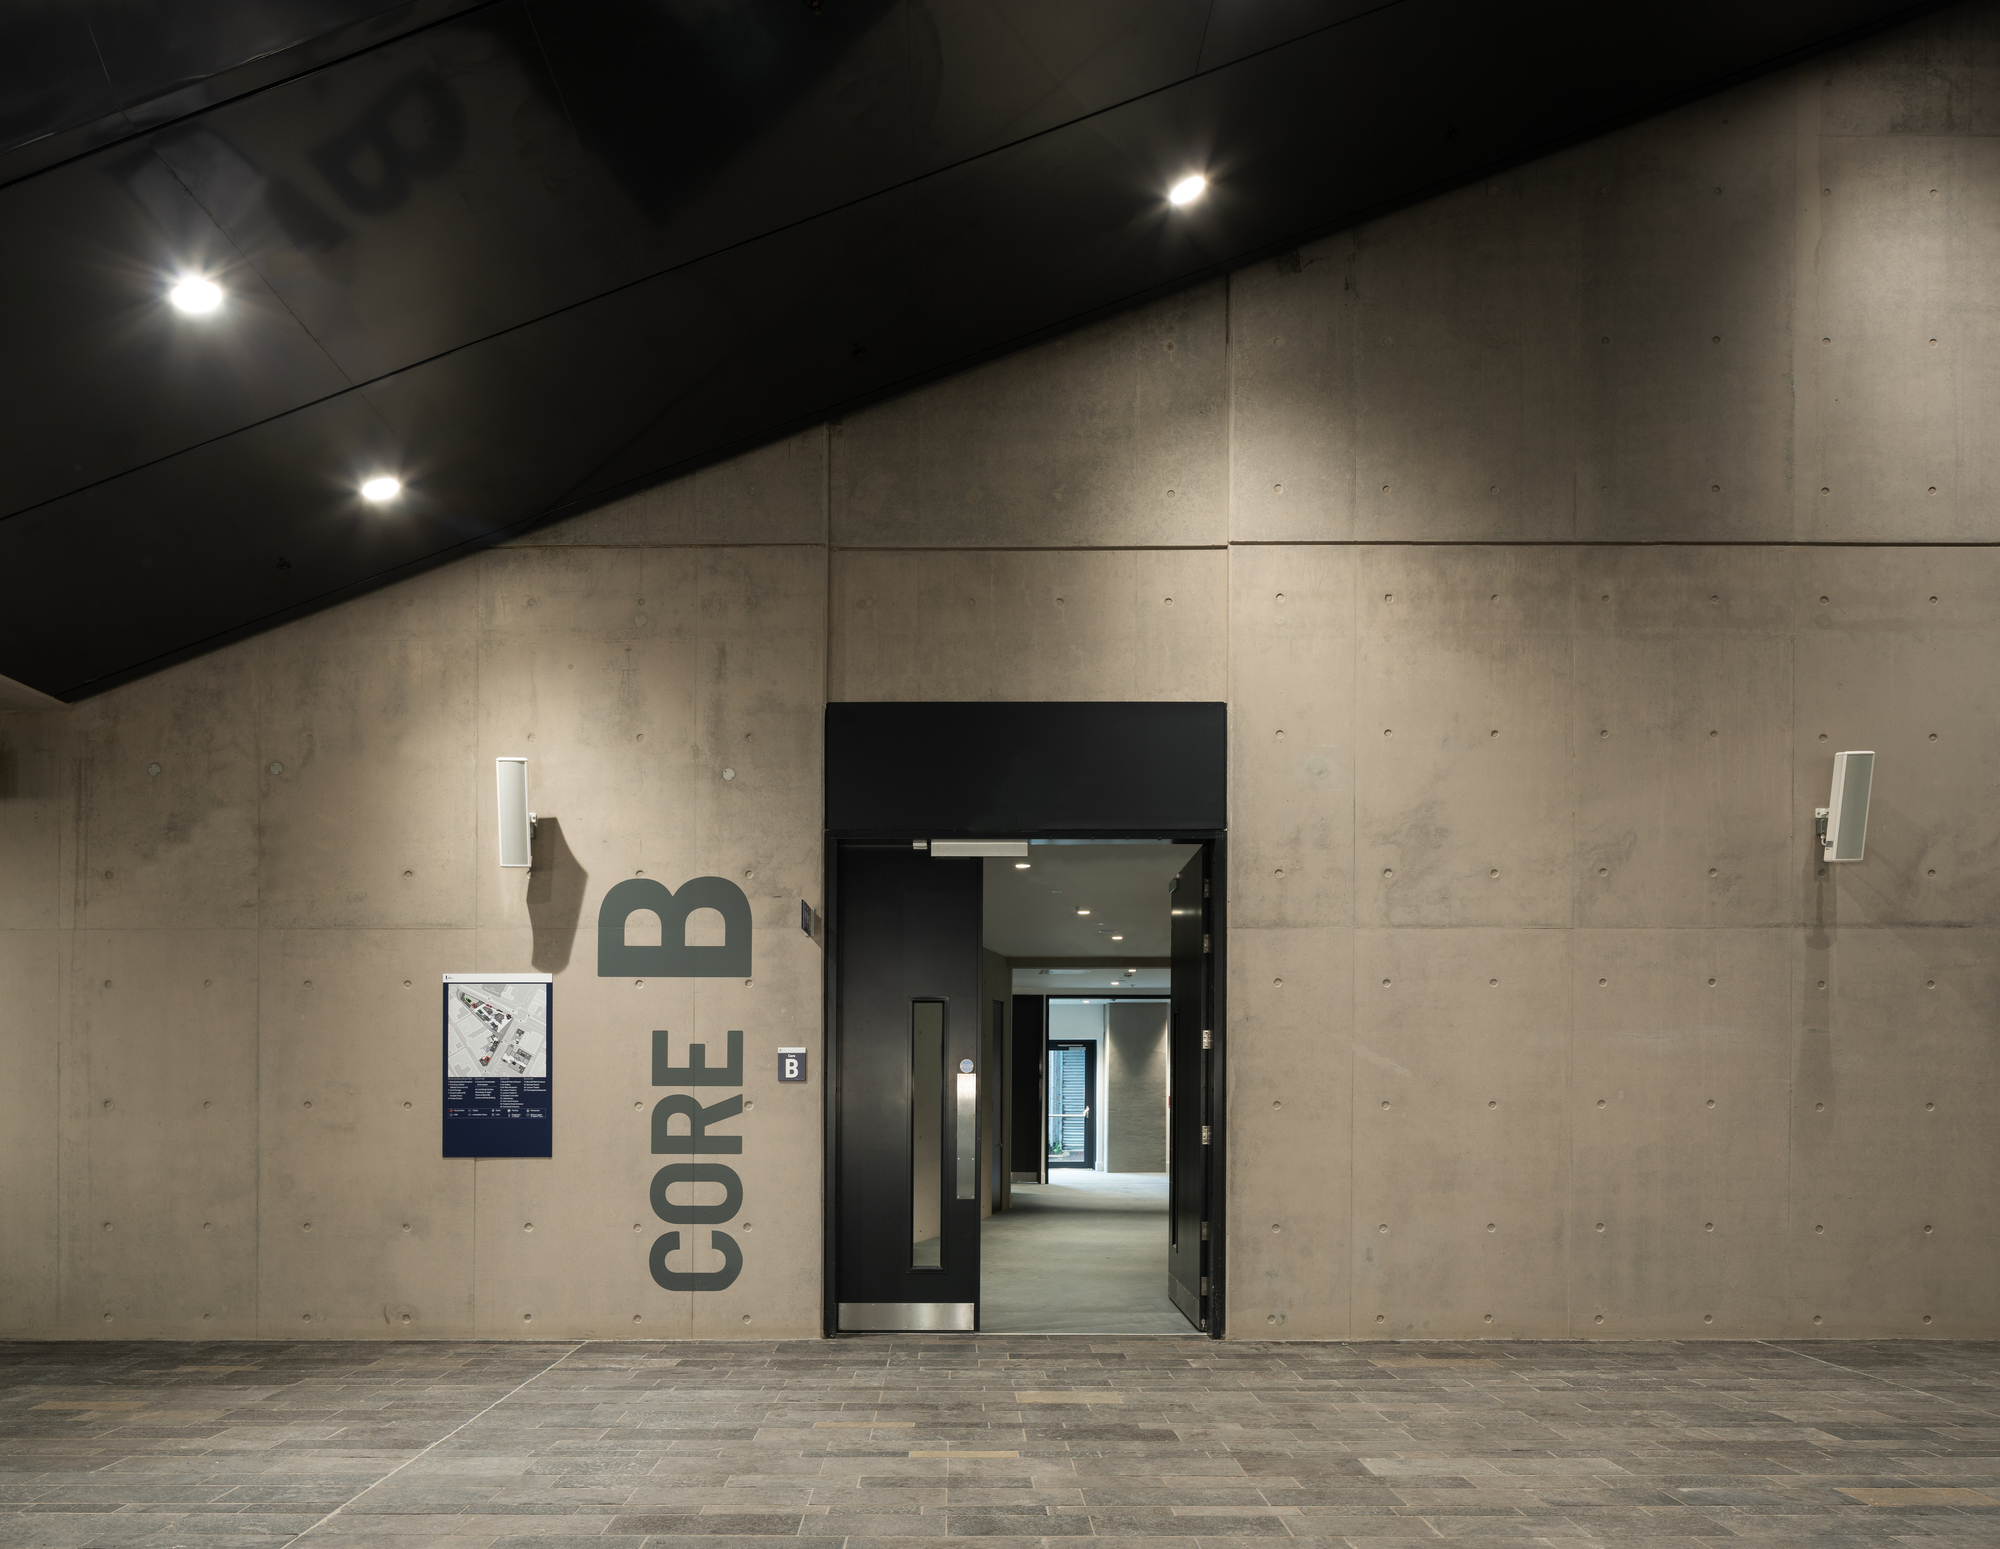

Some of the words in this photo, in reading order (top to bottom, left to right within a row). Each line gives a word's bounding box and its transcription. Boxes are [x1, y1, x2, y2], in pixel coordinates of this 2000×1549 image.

[598, 876, 752, 977] B
[785, 1058, 799, 1078] B
[649, 1030, 743, 1291] CORE
